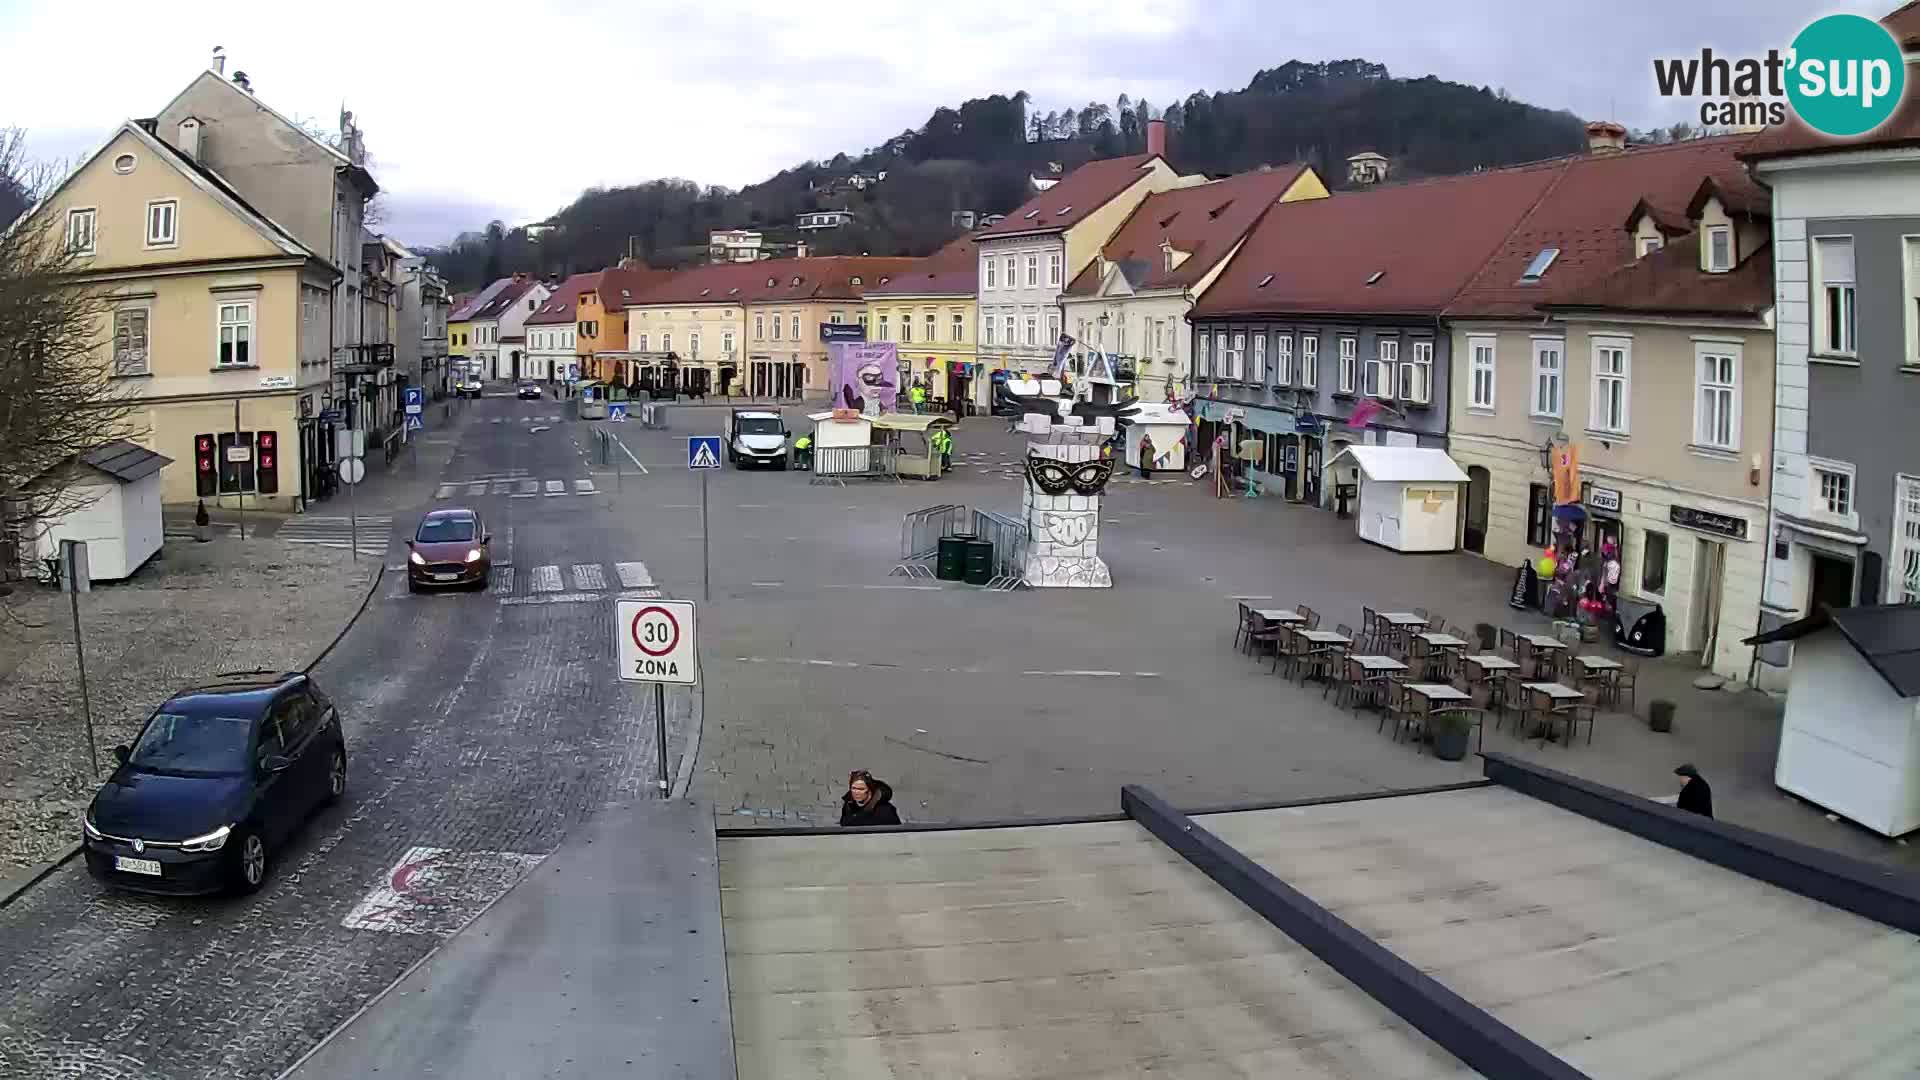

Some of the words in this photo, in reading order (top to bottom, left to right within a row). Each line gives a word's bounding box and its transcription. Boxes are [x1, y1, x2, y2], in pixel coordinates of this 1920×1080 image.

[409, 391, 418, 402] P
[644, 622, 668, 643] 30
[635, 659, 679, 676] ZONA
